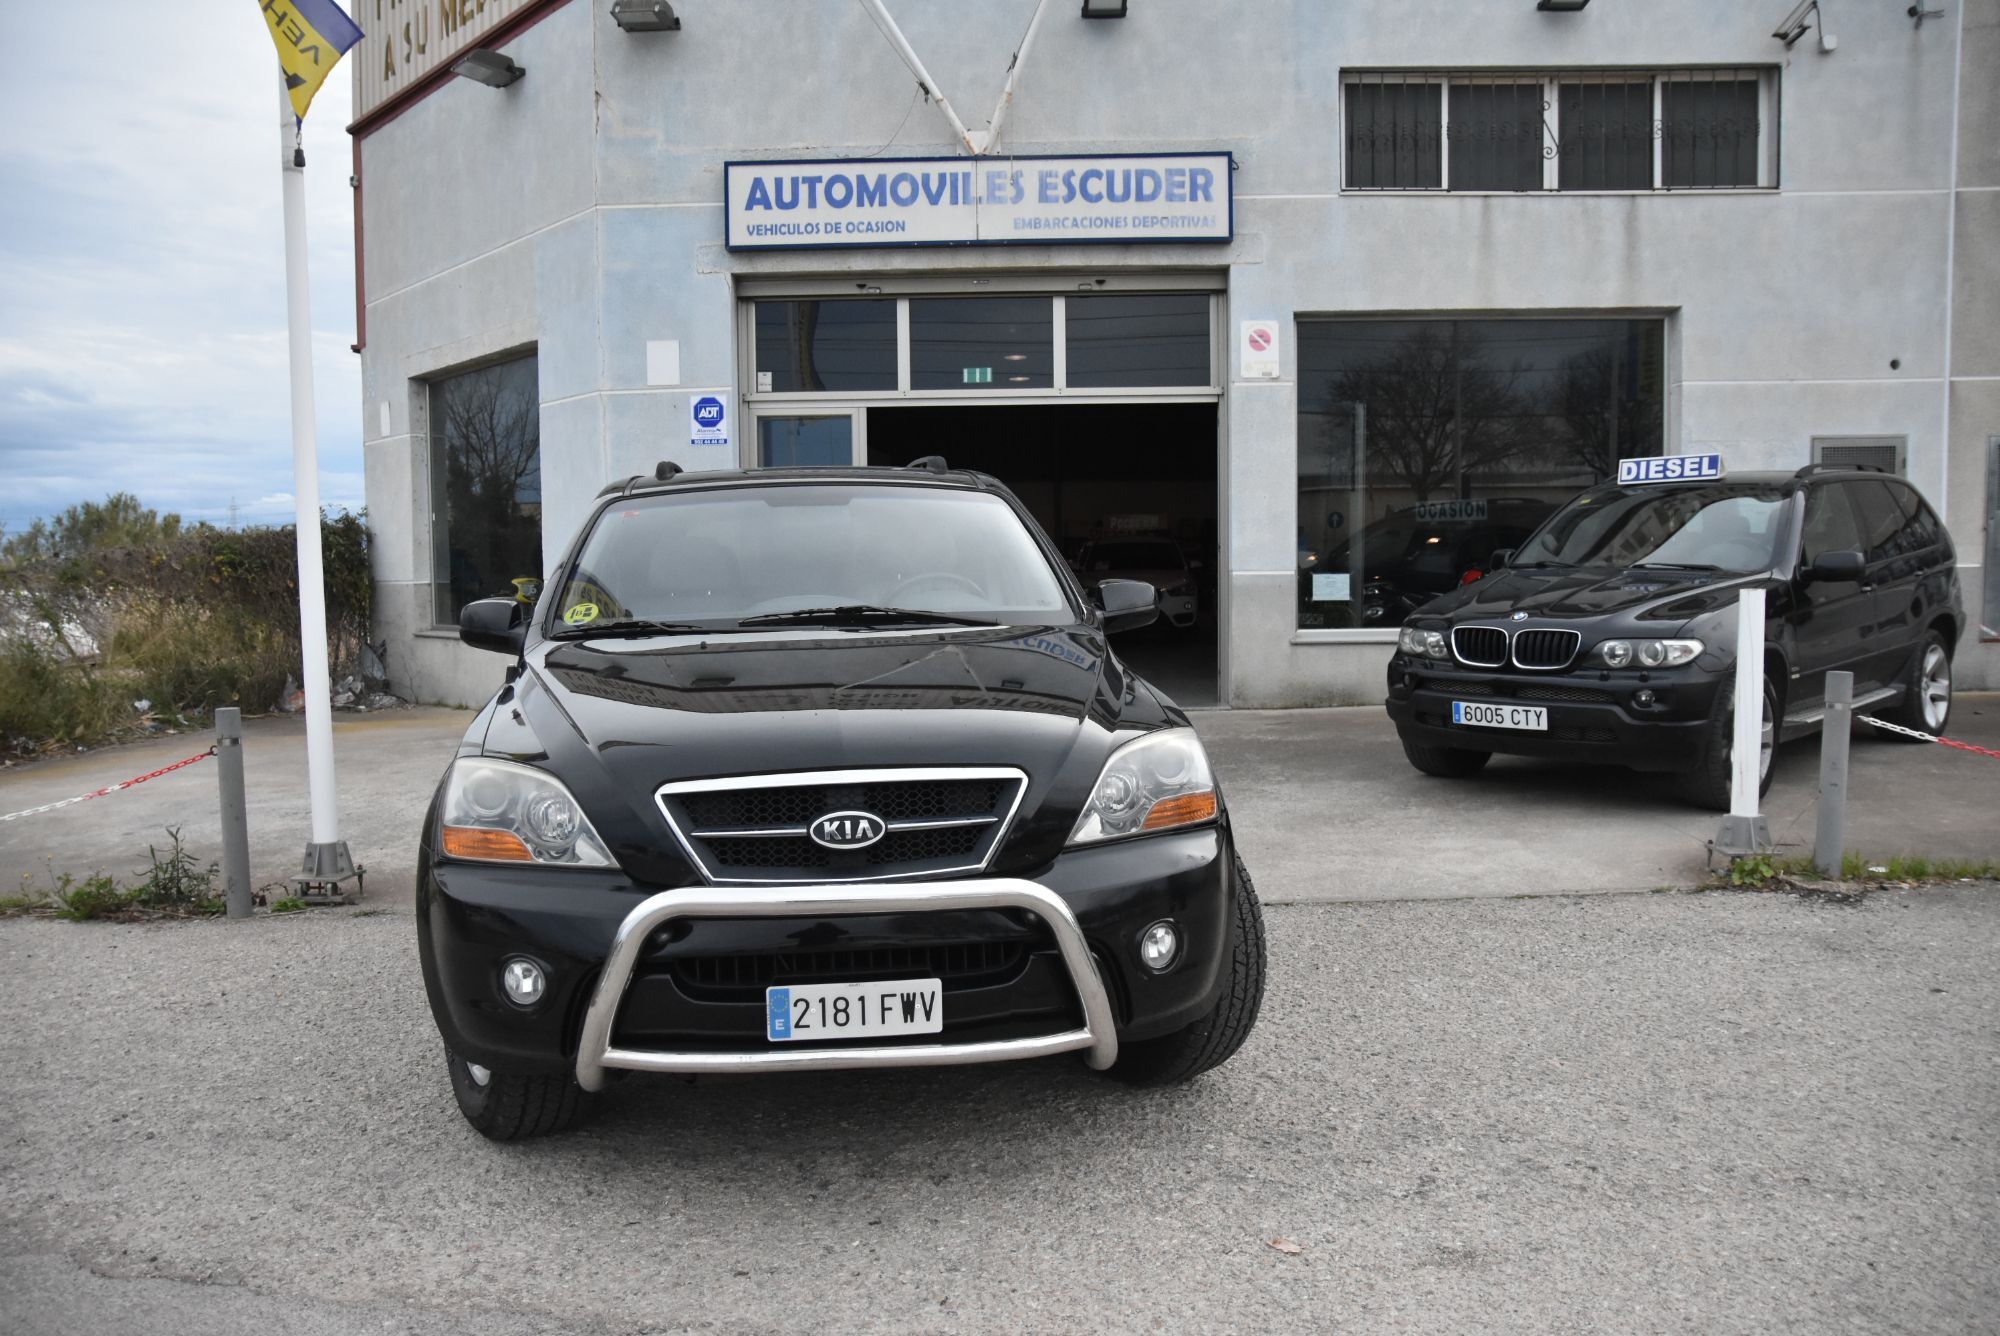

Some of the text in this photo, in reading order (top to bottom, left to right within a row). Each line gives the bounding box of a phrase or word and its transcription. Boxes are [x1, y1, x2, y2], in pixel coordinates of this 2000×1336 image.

[383, 34, 397, 81] A
[403, 5, 429, 64] SU
[745, 168, 1215, 211] AUTOMOVILES ESCUDER
[746, 220, 906, 236] VEHICULOS DE OCASION
[1013, 214, 1217, 230] EMBARCACIONES DEPORTIVAS
[698, 407, 719, 418] ADT
[1620, 457, 1717, 480] DIESEL
[1417, 501, 1486, 520] OCASION
[1464, 706, 1543, 727] 6005 CTY
[822, 819, 874, 840] KIA
[793, 991, 935, 1029] 2181 FWV
[775, 1019, 785, 1031] E
